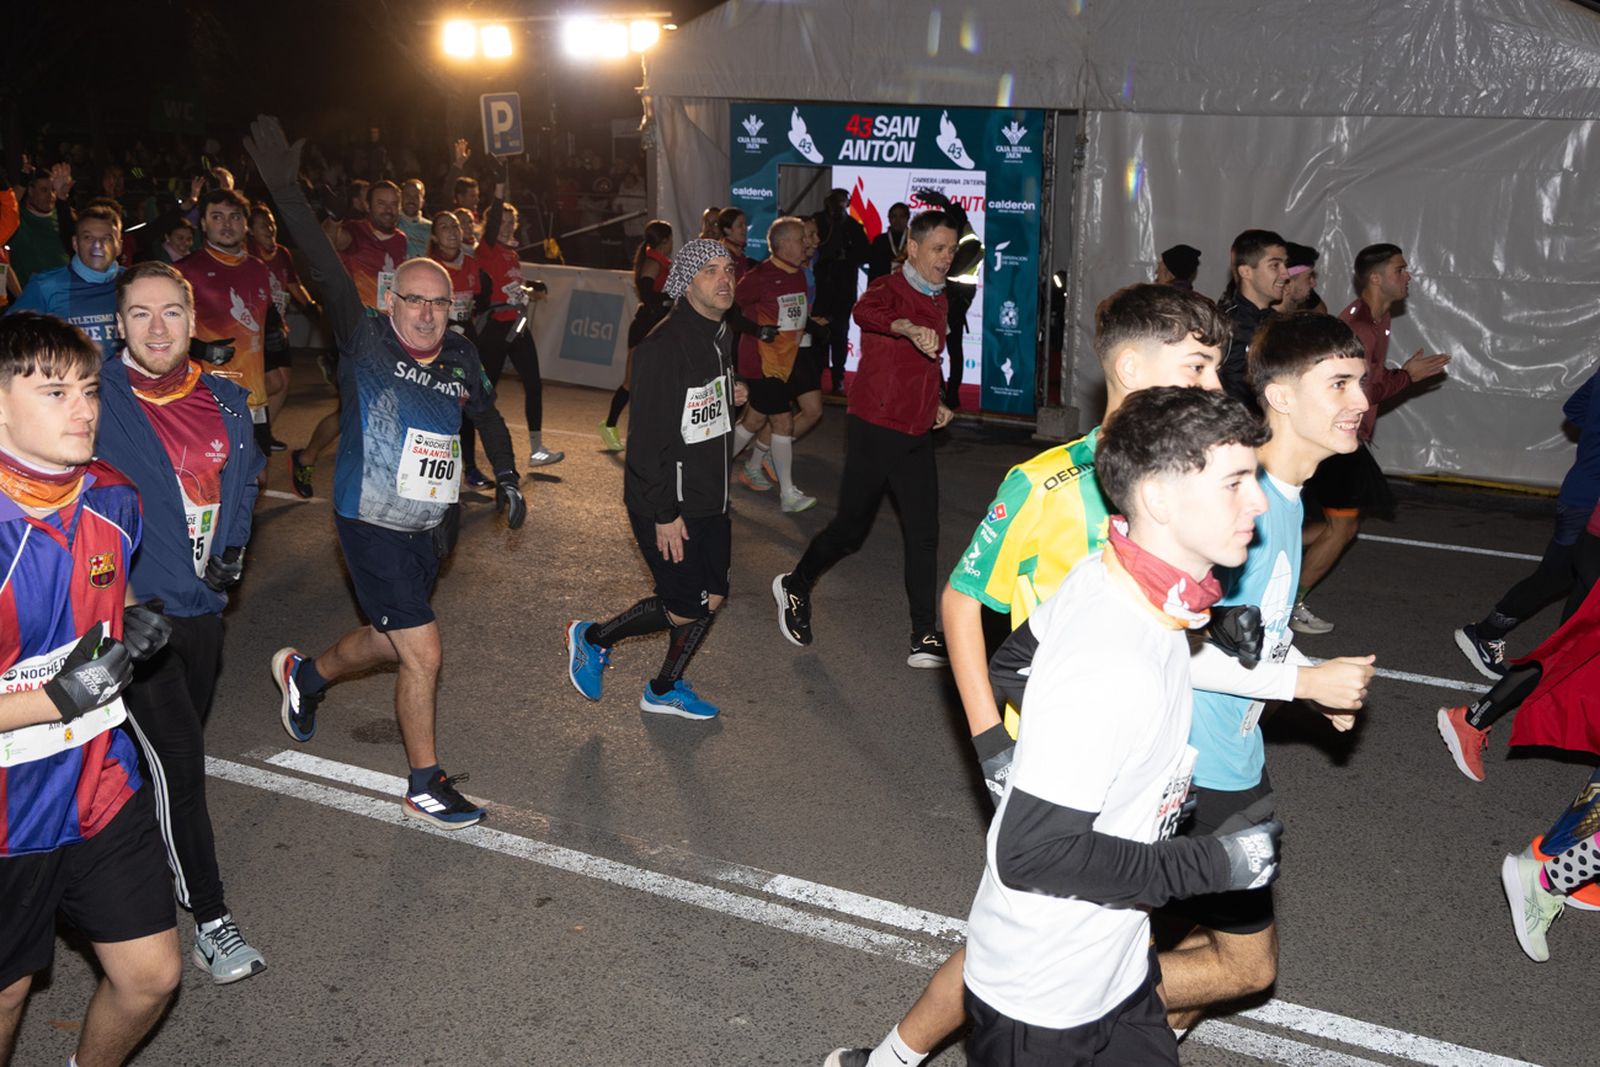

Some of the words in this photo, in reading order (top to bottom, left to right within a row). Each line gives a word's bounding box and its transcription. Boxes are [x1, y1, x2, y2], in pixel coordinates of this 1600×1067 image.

[490, 101, 514, 149] P
[799, 138, 812, 154] 43
[838, 135, 916, 163] ANTÓN
[948, 143, 962, 160] 43
[732, 186, 773, 197] calderón
[988, 200, 1036, 211] calderón
[571, 317, 614, 340] alsa
[394, 361, 431, 386] SAN
[691, 400, 722, 424] 5062
[412, 446, 429, 456] SAN
[419, 457, 455, 481] 1160
[20, 661, 60, 680] NOCHE
